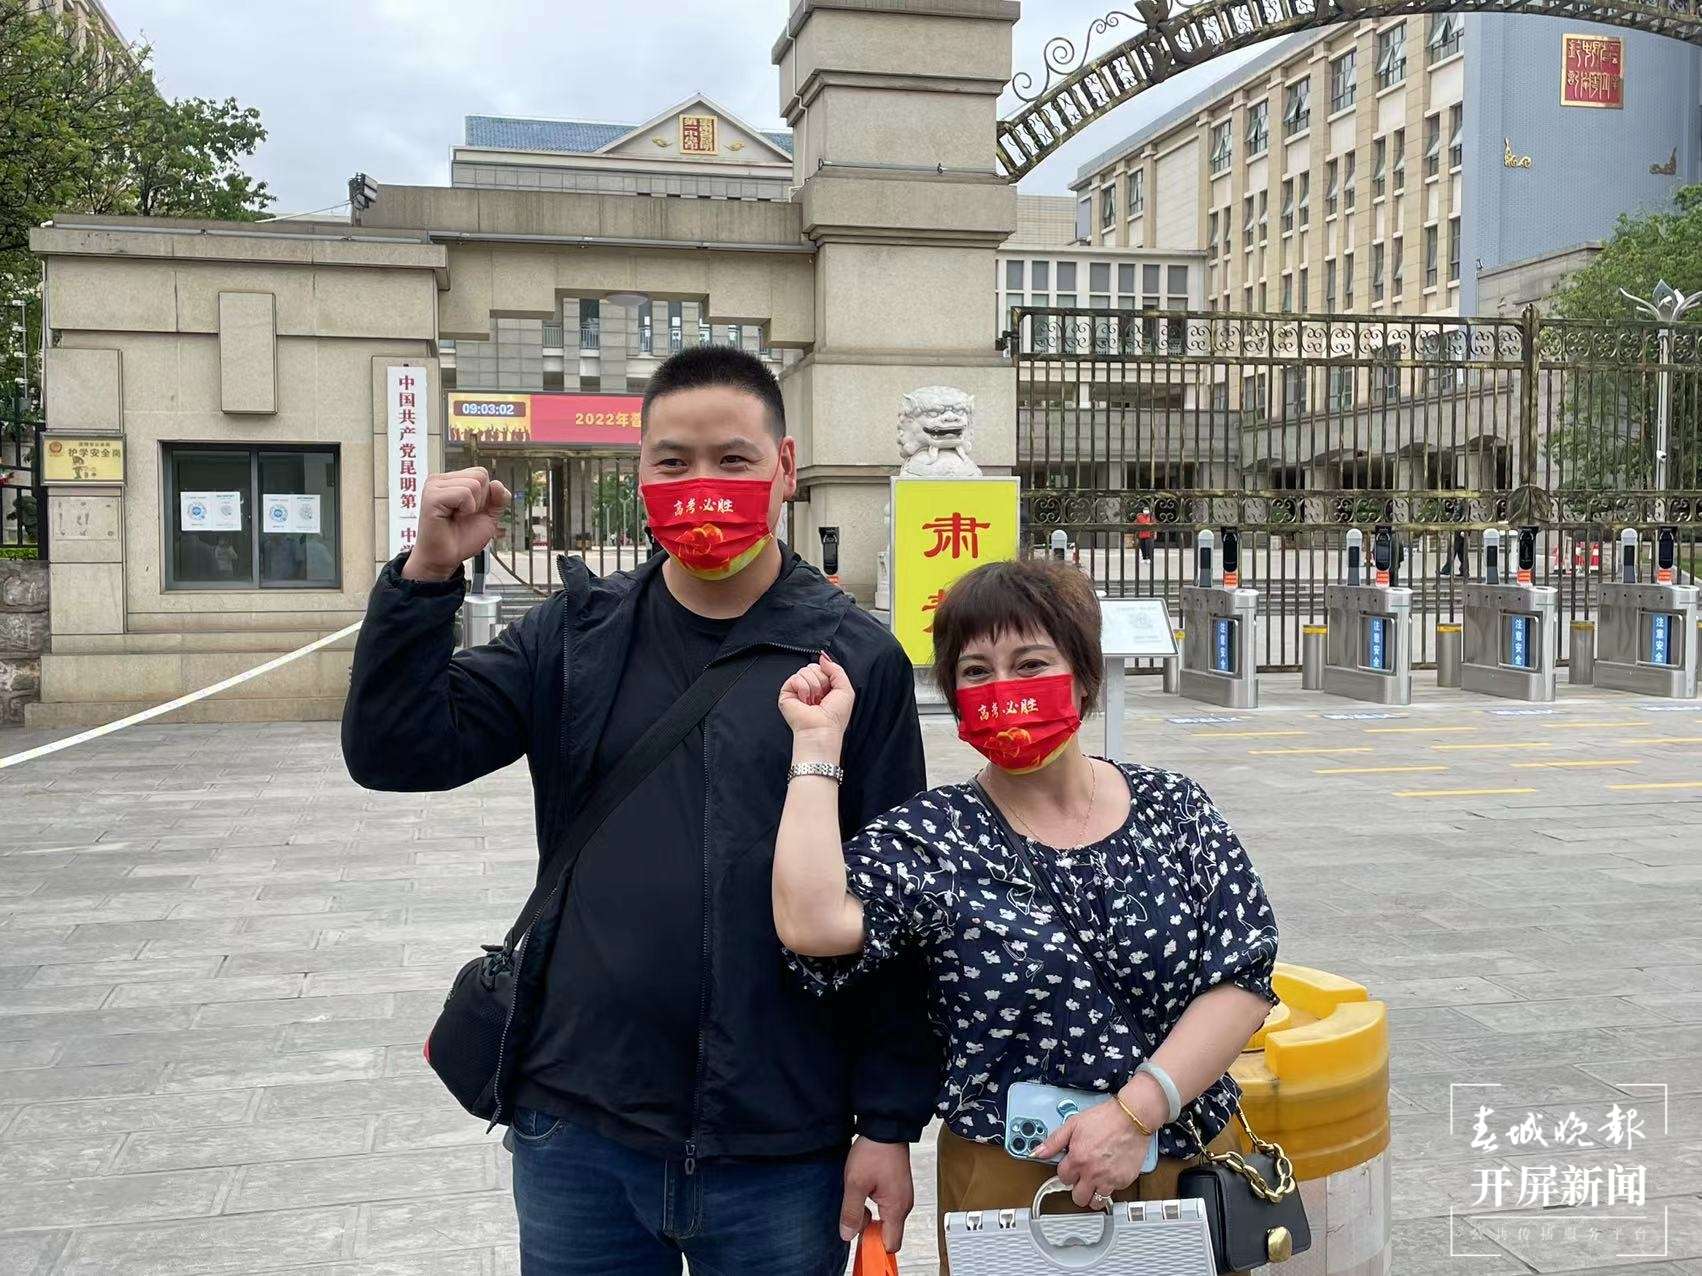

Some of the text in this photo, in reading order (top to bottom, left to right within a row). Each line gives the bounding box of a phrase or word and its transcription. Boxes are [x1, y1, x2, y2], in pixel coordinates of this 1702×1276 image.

[462, 403, 514, 415] 09:03:02
[673, 498, 734, 517] 高考必胜
[1514, 617, 1523, 666] 注意安全
[1655, 616, 1664, 664] 注意安全
[977, 697, 1039, 721] 高考必胜
